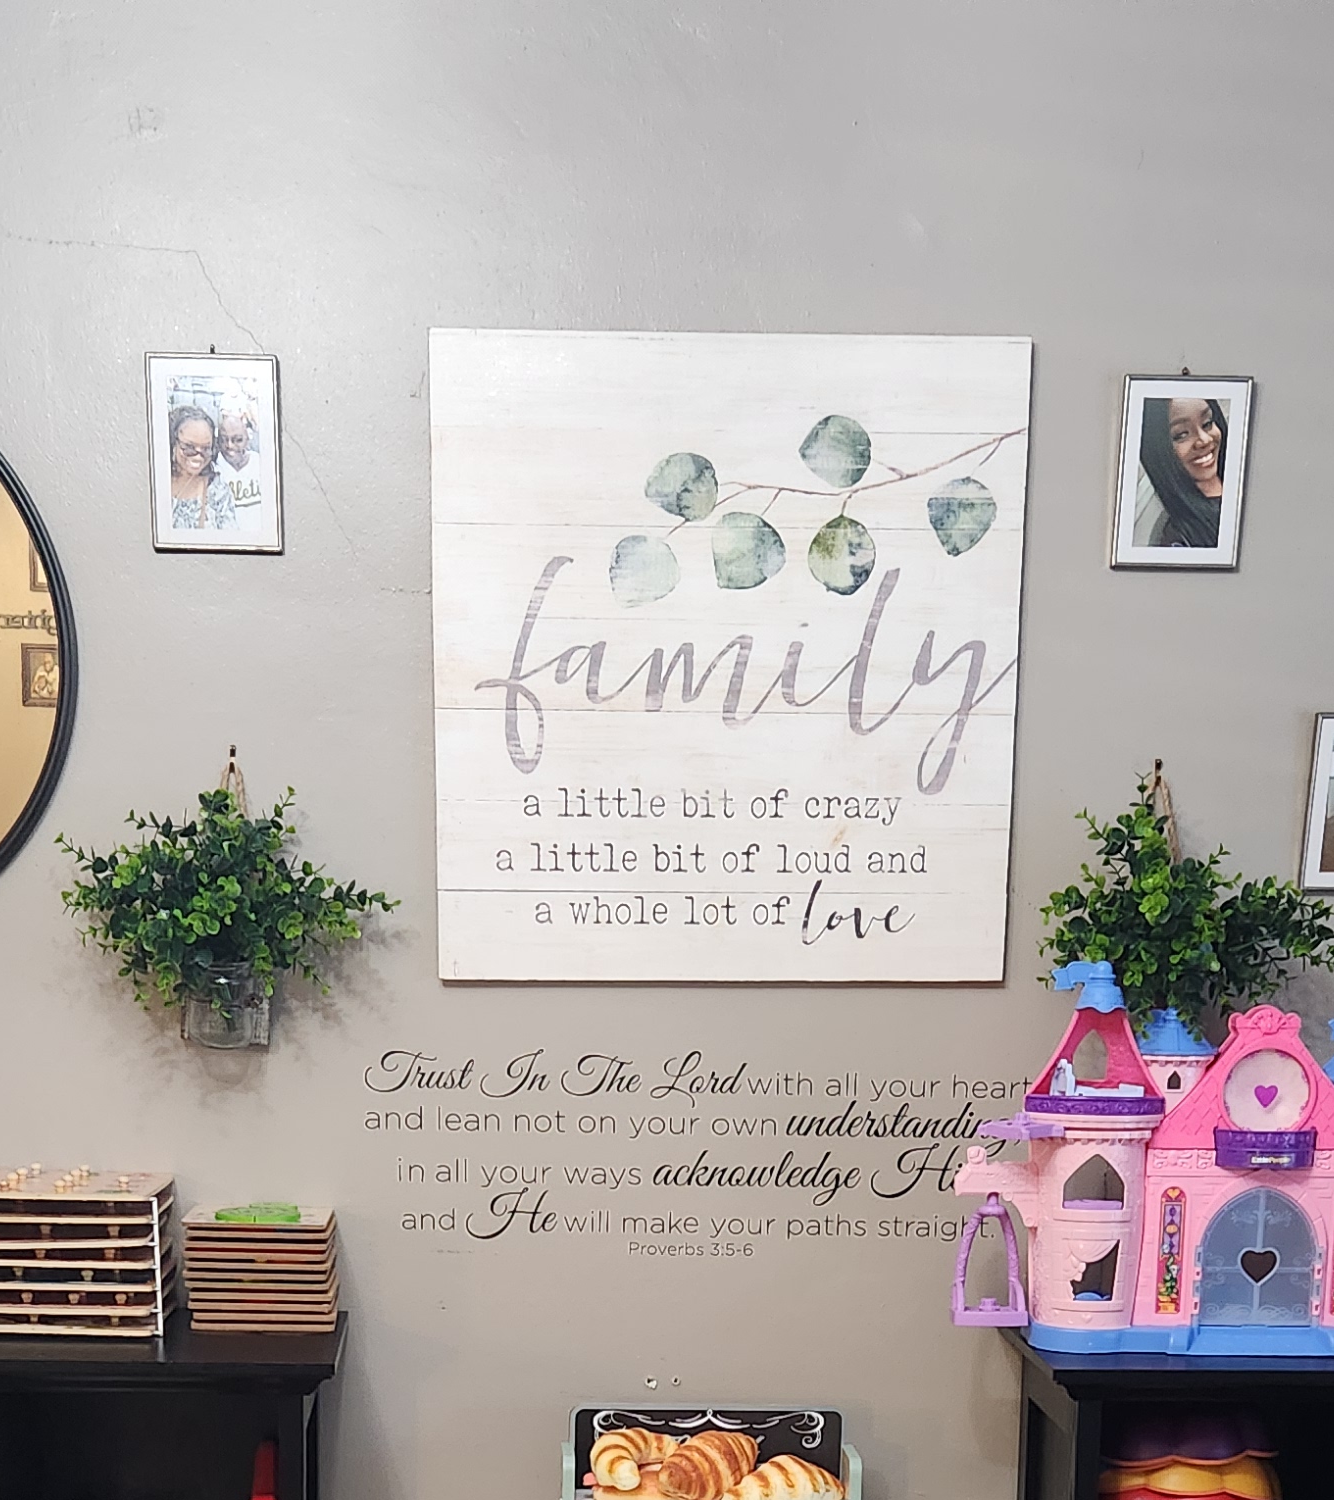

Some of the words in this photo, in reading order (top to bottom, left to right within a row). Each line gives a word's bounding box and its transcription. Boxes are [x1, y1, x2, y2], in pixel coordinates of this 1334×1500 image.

[475, 556, 1016, 795] family
[524, 795, 541, 817] a
[558, 788, 665, 818] little
[681, 789, 734, 818] bit
[751, 788, 788, 819] of
[805, 796, 902, 826] crazy
[496, 850, 514, 871] a
[531, 843, 637, 872] little
[652, 843, 706, 873] bit
[723, 843, 760, 873] of
[777, 844, 851, 874] loud
[868, 845, 927, 873] and
[535, 902, 553, 924] a
[569, 896, 667, 925] whole
[684, 896, 737, 925] lot
[753, 896, 790, 925] of
[802, 879, 915, 945] love
[365, 1051, 474, 1092] Trust
[480, 1049, 550, 1098] In
[561, 1055, 642, 1096] The
[650, 1051, 747, 1108] Lord
[748, 1072, 812, 1096] with
[826, 1073, 857, 1096] all
[870, 1080, 940, 1102] your
[365, 1107, 422, 1130] and
[438, 1107, 500, 1132] lean
[515, 1110, 565, 1133] not
[579, 1116, 615, 1133] on
[629, 1117, 700, 1139] your
[712, 1118, 776, 1136] own
[786, 1101, 1020, 1158] understandi,
[399, 1157, 424, 1182] in
[436, 1159, 467, 1183] all
[481, 1166, 551, 1191] your
[564, 1167, 641, 1189] ways
[653, 1150, 861, 1206] acknowledge
[870, 1143, 964, 1199] Hi
[402, 1208, 455, 1230] and
[466, 1189, 557, 1239] He
[564, 1211, 609, 1233] will
[623, 1212, 698, 1234] make
[710, 1218, 775, 1238] your
[787, 1214, 866, 1239] paths
[629, 1242, 704, 1256] Proverbs
[710, 1243, 753, 1256] 3:5-6
